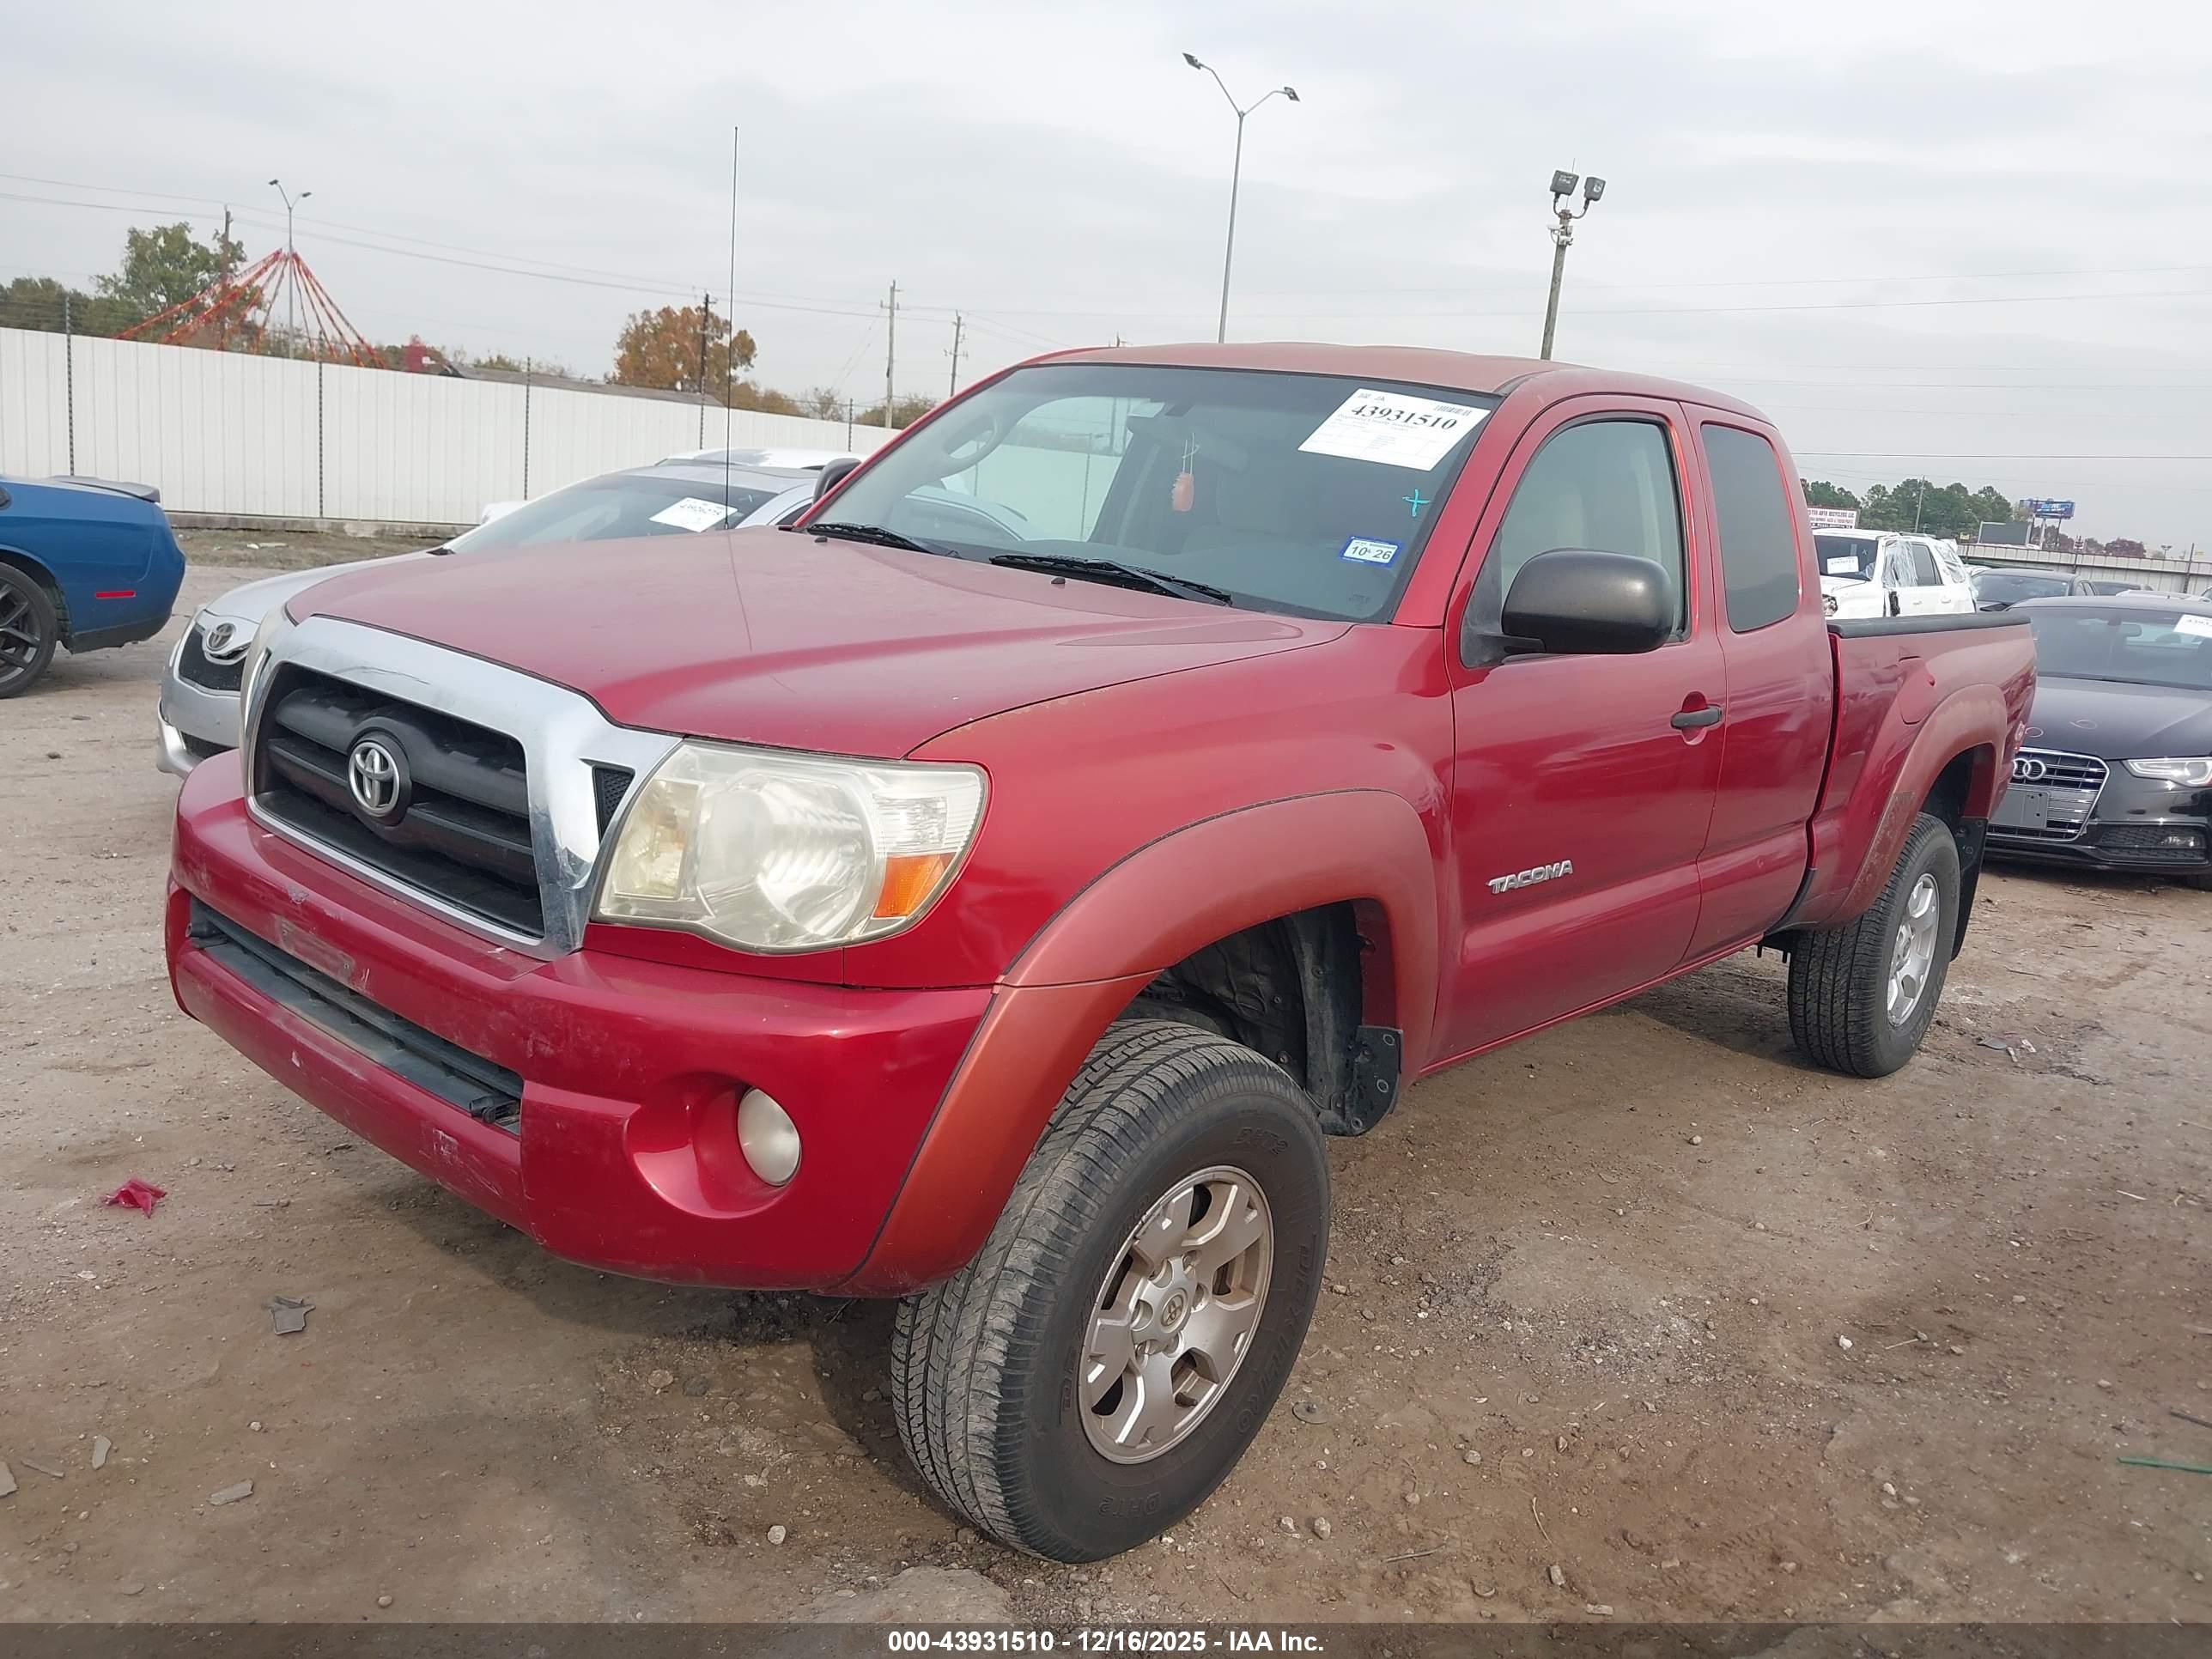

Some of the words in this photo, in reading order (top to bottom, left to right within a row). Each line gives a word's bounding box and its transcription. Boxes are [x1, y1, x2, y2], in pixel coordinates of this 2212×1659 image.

[1352, 404, 1457, 430] 43931510
[1352, 545, 1367, 556] 10
[1372, 550, 1392, 560] 26
[1486, 860, 1573, 894] TACOMA
